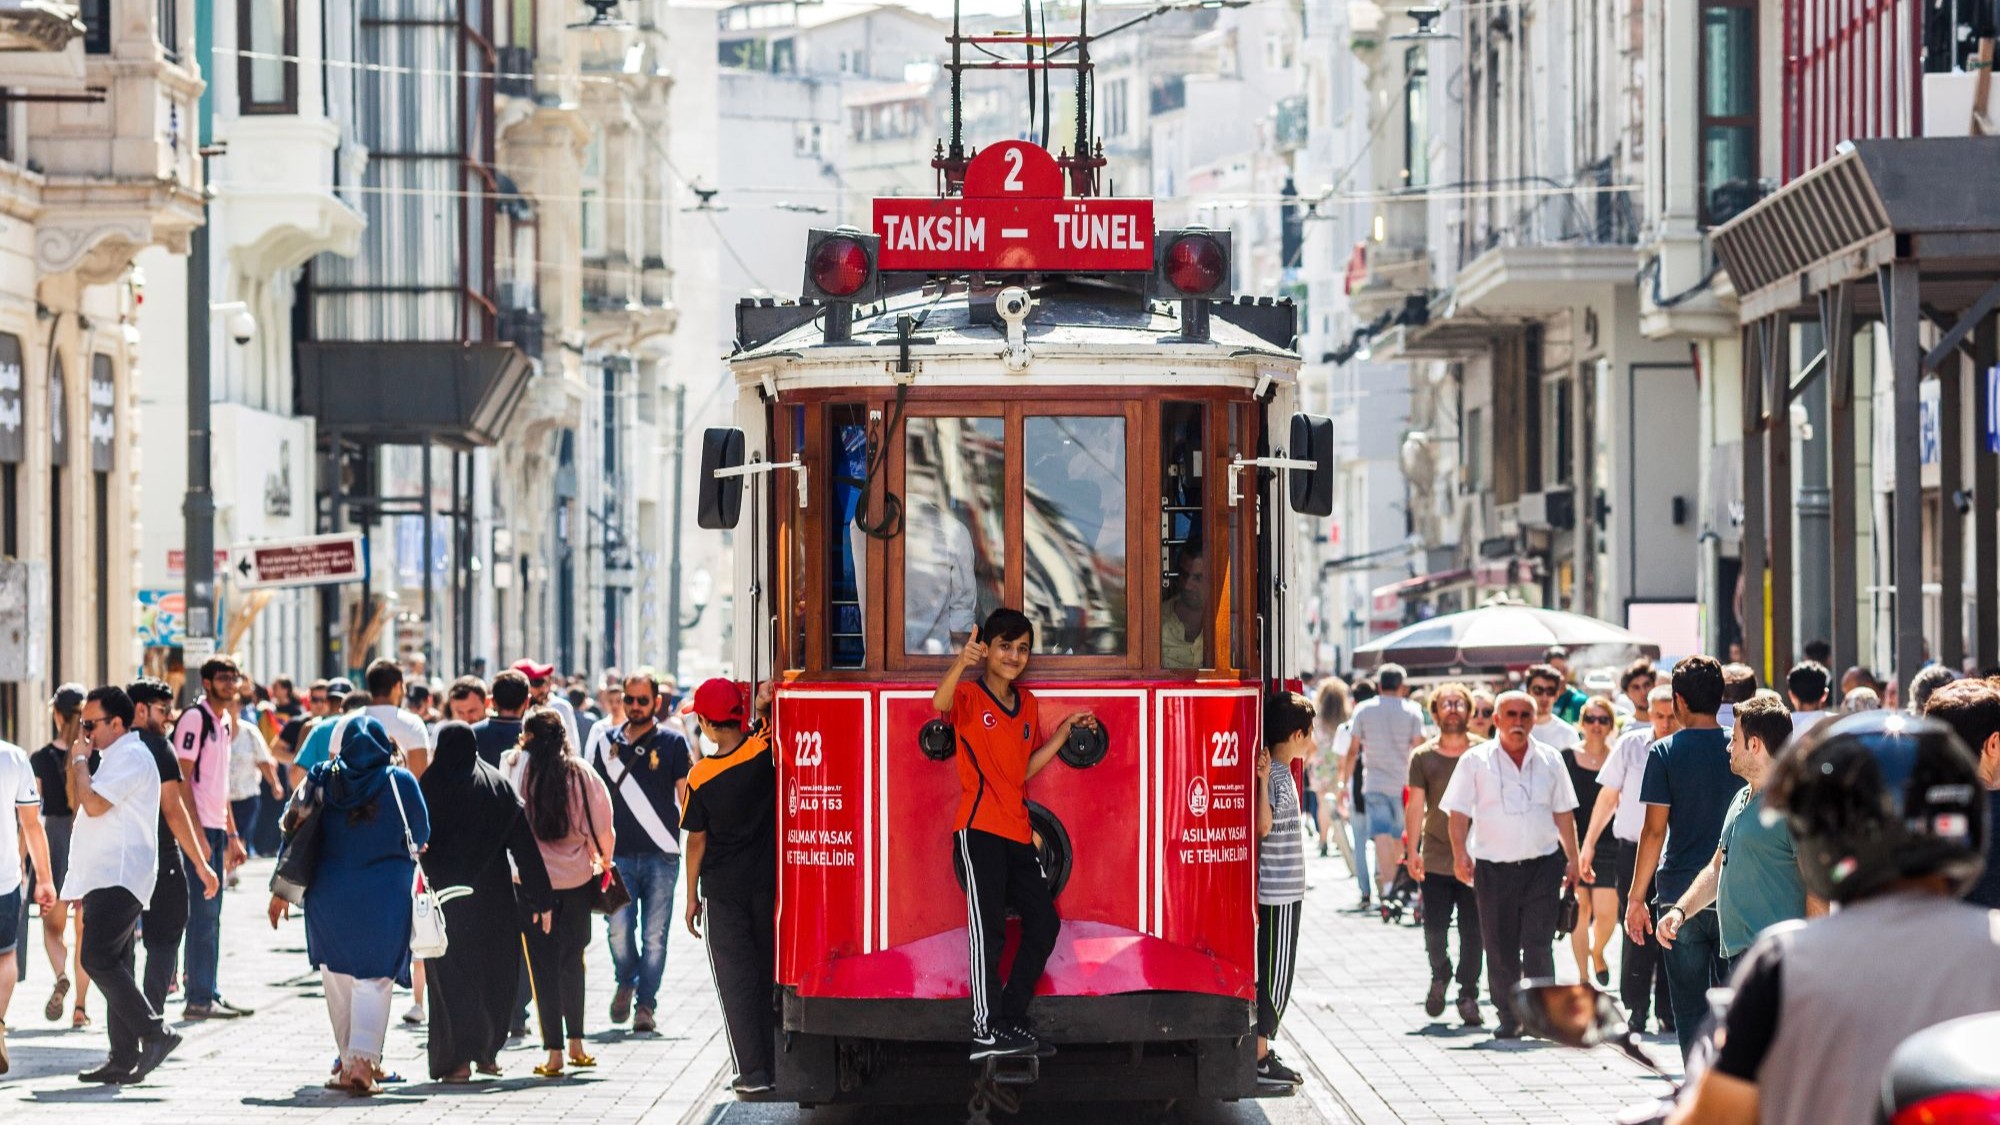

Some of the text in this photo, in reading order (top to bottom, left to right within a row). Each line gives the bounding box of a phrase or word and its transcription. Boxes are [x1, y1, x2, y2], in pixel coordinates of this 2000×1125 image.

[1004, 147, 1024, 192] 2
[883, 206, 986, 252] TAKSİM
[1053, 204, 1145, 250] TÜNEL
[795, 731, 822, 767] 223
[1211, 731, 1239, 767] 223
[800, 798, 818, 810] ALO
[821, 798, 842, 810] 153
[1212, 797, 1232, 809] ALO
[787, 829, 853, 845] ASILMAK YASAK
[1182, 826, 1247, 843] ASILMAK YASAK
[793, 848, 855, 866] TEHLİKELİDİR
[1179, 844, 1248, 864] VE TEHLİKELİDİR
